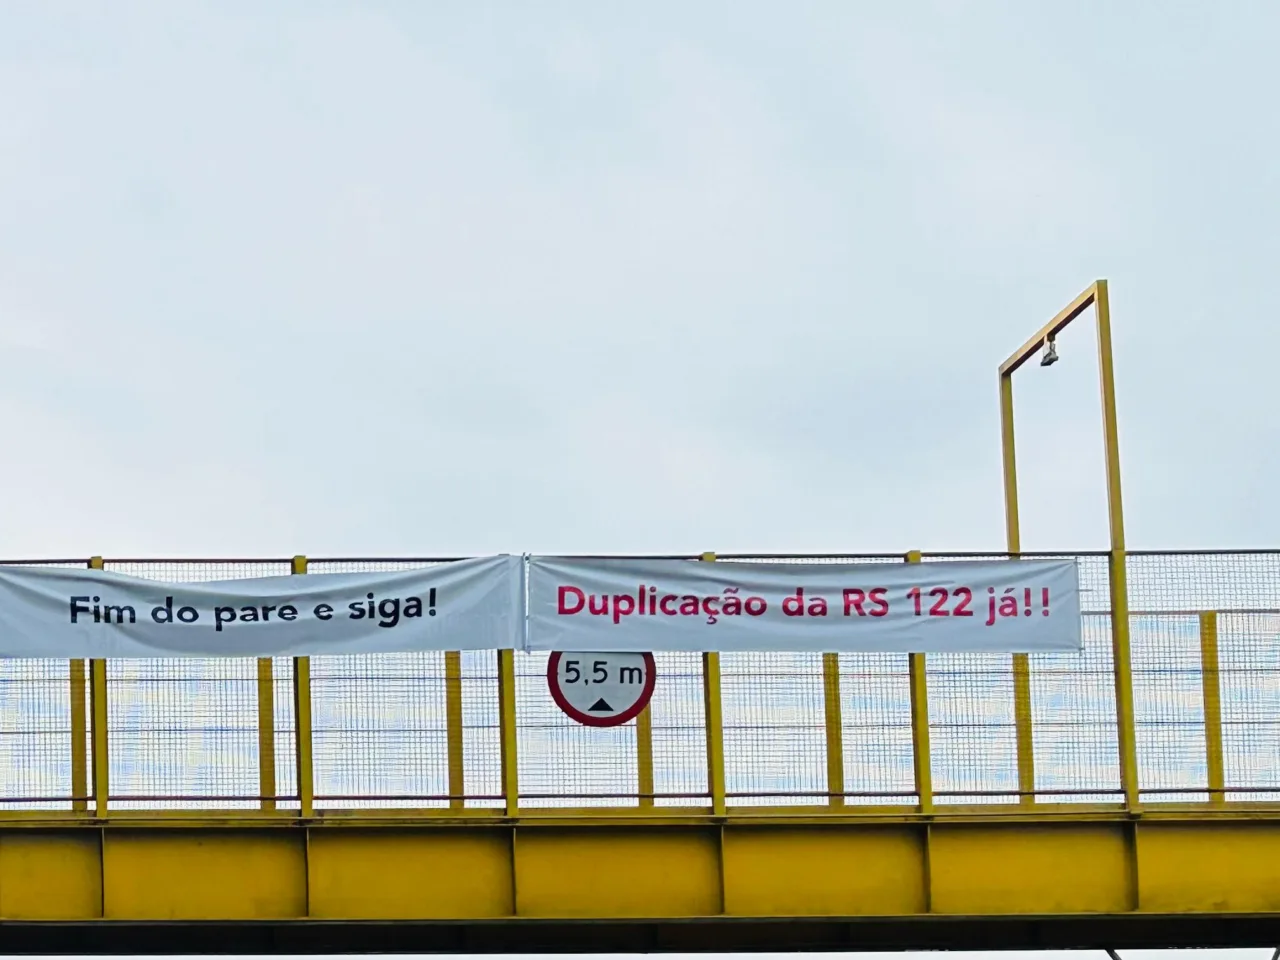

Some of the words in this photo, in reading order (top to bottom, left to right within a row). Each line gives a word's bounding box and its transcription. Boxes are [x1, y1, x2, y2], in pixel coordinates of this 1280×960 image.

[70, 596, 137, 625] Fim
[151, 595, 200, 624] do
[214, 600, 299, 632] pare
[313, 603, 334, 621] e
[348, 587, 437, 629] siga!
[557, 585, 768, 625] Duplicação
[781, 587, 828, 617] da
[843, 587, 889, 617] RS
[906, 586, 974, 617] 122
[986, 586, 1051, 627] já!!
[565, 661, 608, 686] 5,5
[619, 666, 643, 684] m
